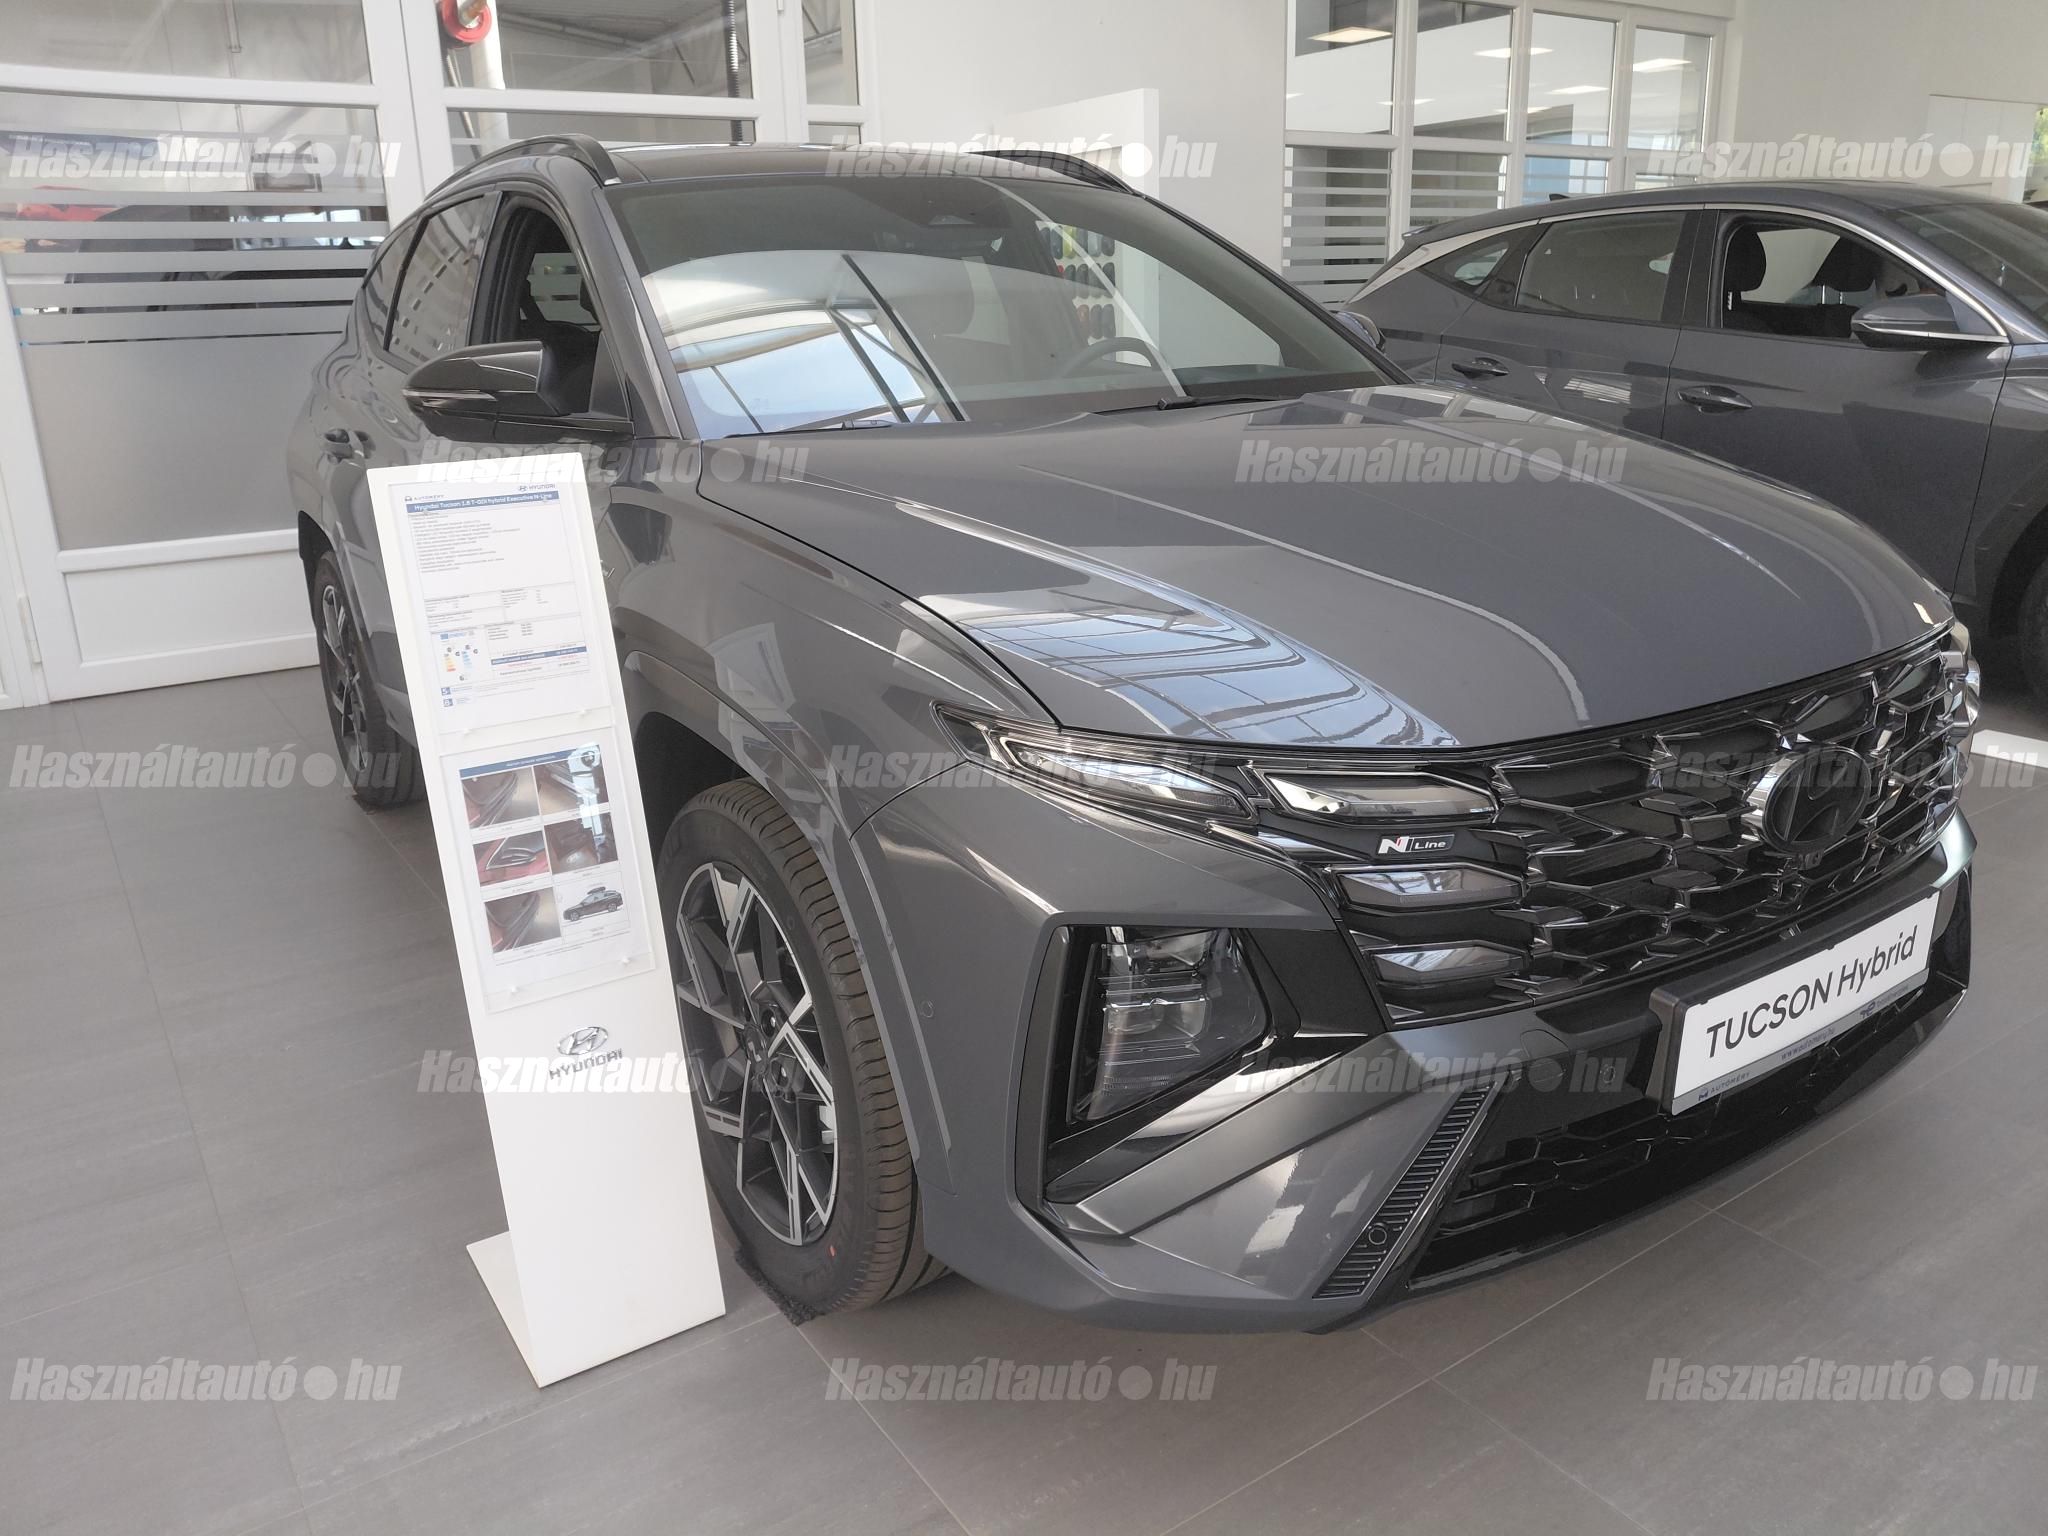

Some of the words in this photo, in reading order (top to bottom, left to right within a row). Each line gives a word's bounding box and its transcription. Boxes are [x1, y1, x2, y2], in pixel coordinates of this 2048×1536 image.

[1414, 841, 1447, 850] Line
[1706, 971, 1833, 1058] TUCSON
[1836, 924, 1918, 997] Hybrid
[548, 1047, 624, 1081] HYUNDAI
